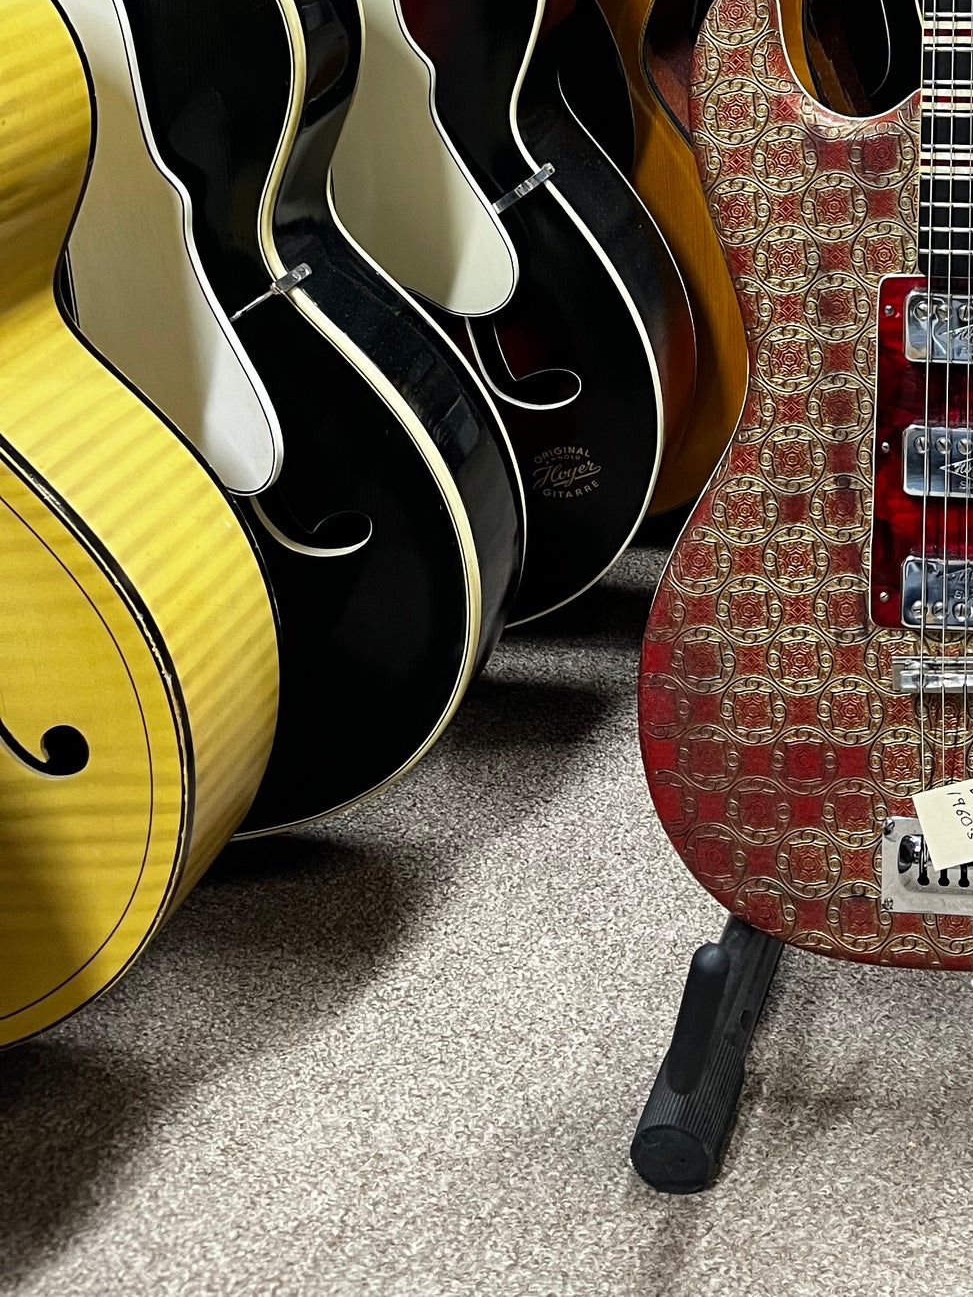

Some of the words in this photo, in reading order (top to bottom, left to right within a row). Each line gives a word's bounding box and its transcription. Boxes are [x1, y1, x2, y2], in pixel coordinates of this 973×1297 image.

[534, 446, 590, 464] ORIGINAL
[533, 460, 602, 490] Hoyer
[542, 479, 600, 498] GITARRE
